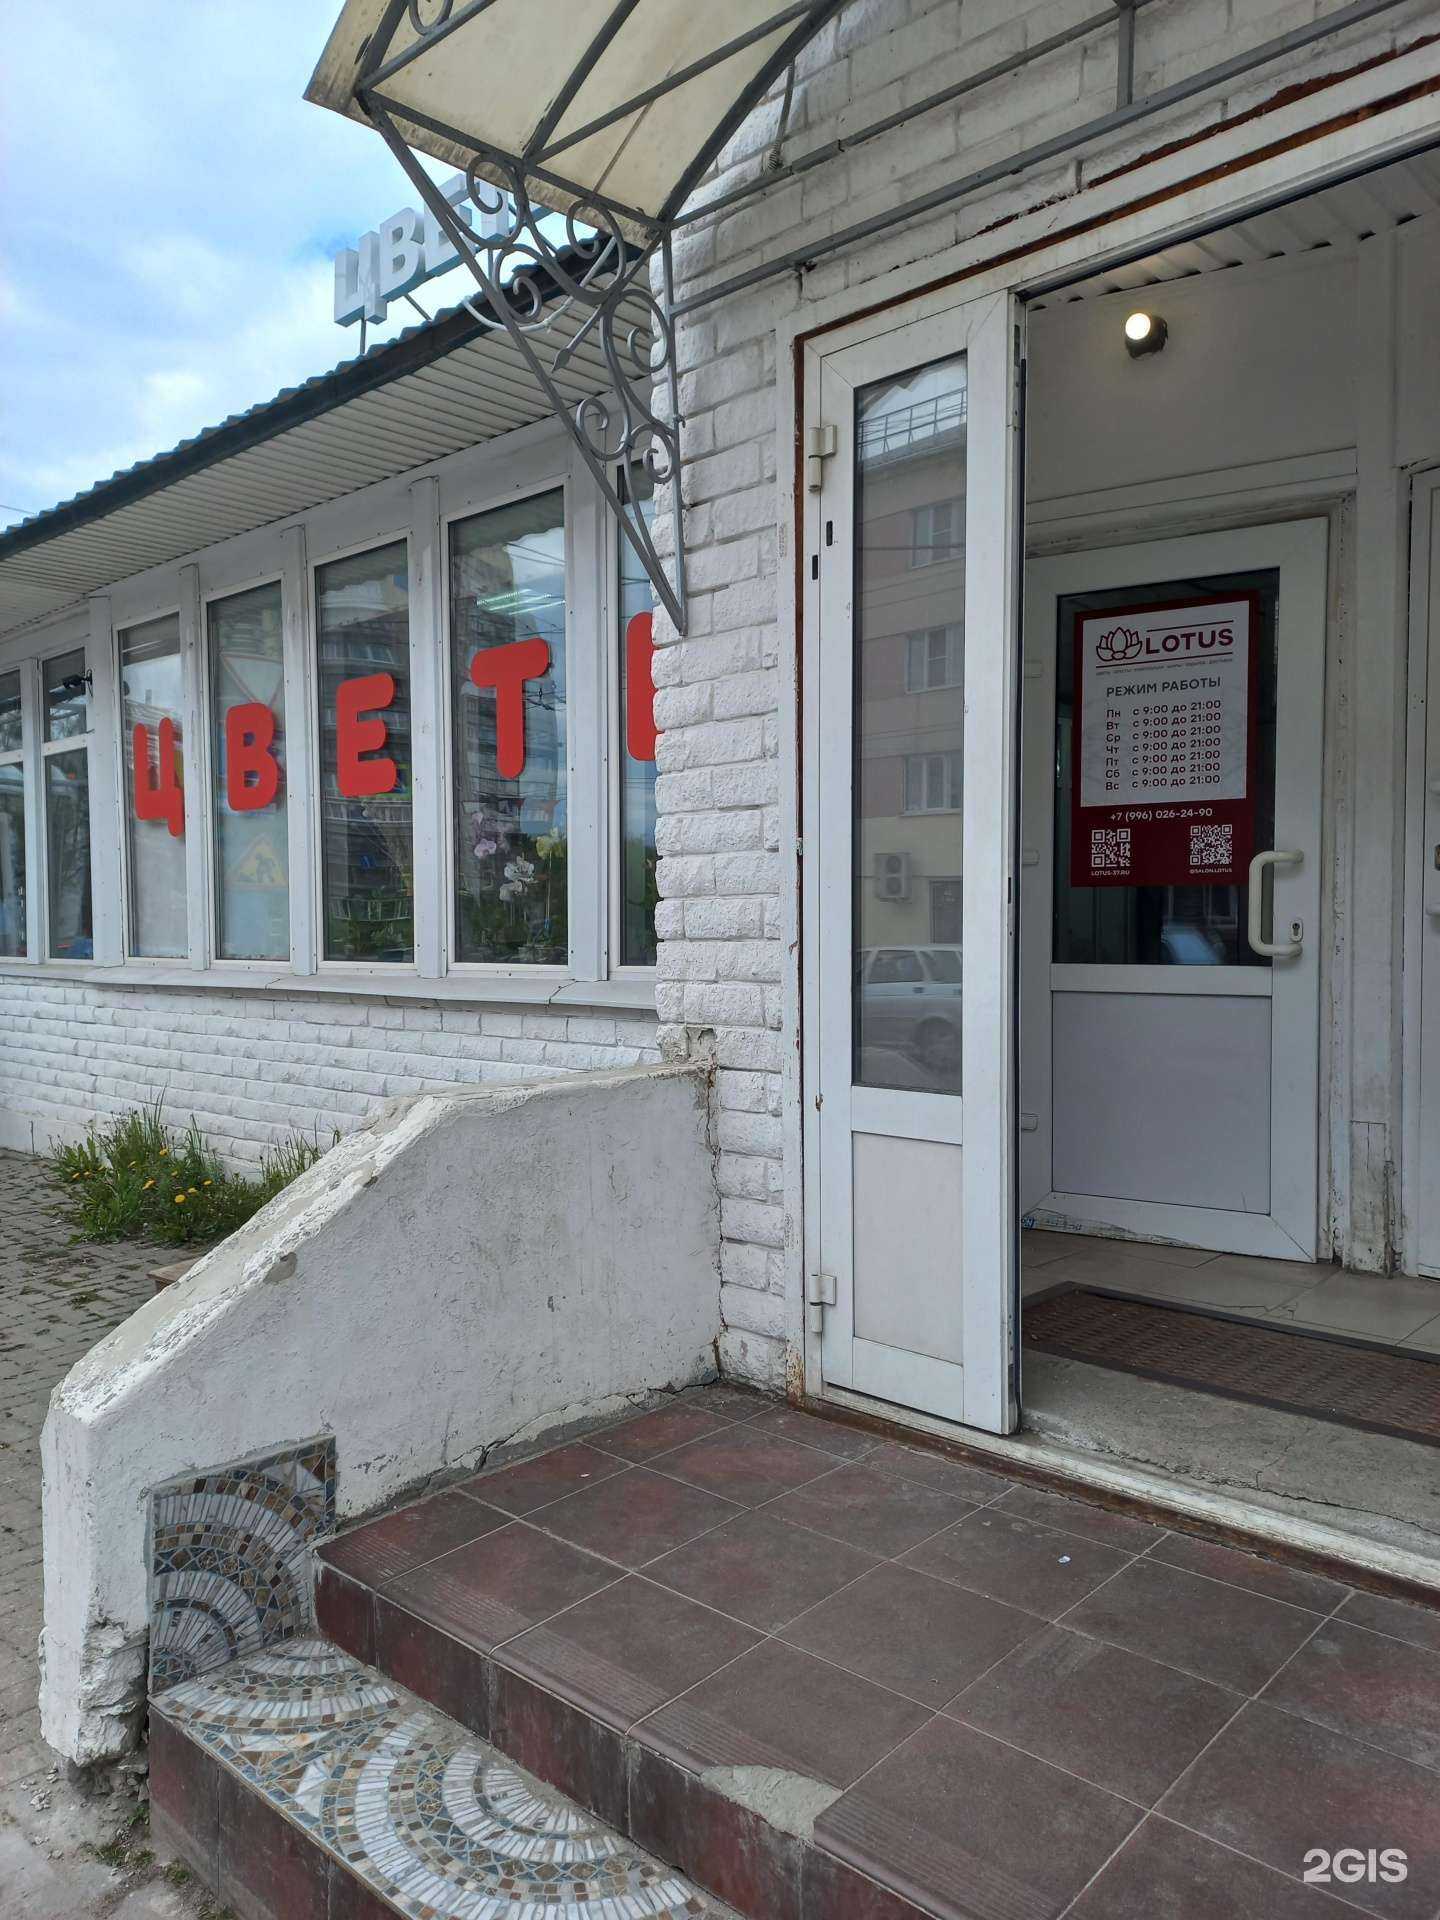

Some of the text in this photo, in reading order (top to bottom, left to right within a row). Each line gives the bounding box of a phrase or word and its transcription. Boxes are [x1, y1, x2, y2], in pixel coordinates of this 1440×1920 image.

[1145, 628, 1234, 655] LOTUS
[1106, 676, 1221, 698] РЕЖИМ РАБОТЫ
[1106, 710, 1120, 718] Пн
[1143, 705, 1168, 714] 9:00
[1171, 704, 1187, 713] до
[1191, 700, 1220, 711] 21:00
[1106, 722, 1119, 730] Вт
[1143, 717, 1168, 726] 9:00
[1171, 717, 1186, 726] до
[1191, 712, 1220, 723] 21:00
[1106, 734, 1120, 743] Ср
[1143, 730, 1168, 739] 9:00
[1171, 730, 1186, 738] до
[1190, 725, 1220, 736] 21:00
[1106, 746, 1119, 754] Чт
[1143, 742, 1168, 751] 9:00
[1171, 742, 1186, 751] до
[1190, 738, 1220, 748] 21:00
[1106, 758, 1119, 766] Пт
[1142, 754, 1168, 763] 9:00
[1171, 754, 1186, 763] до
[1190, 750, 1220, 761] 21:00
[1106, 770, 1120, 778] Сб
[1142, 766, 1167, 775] 9:00
[1171, 766, 1186, 775] до
[1190, 762, 1220, 773] 21:00
[1106, 782, 1119, 790] Вс
[1142, 778, 1167, 787] 9:00
[1171, 779, 1186, 787] до
[1190, 775, 1220, 785] 21:00
[1110, 808, 1213, 822] +7 (996) 026-24-90
